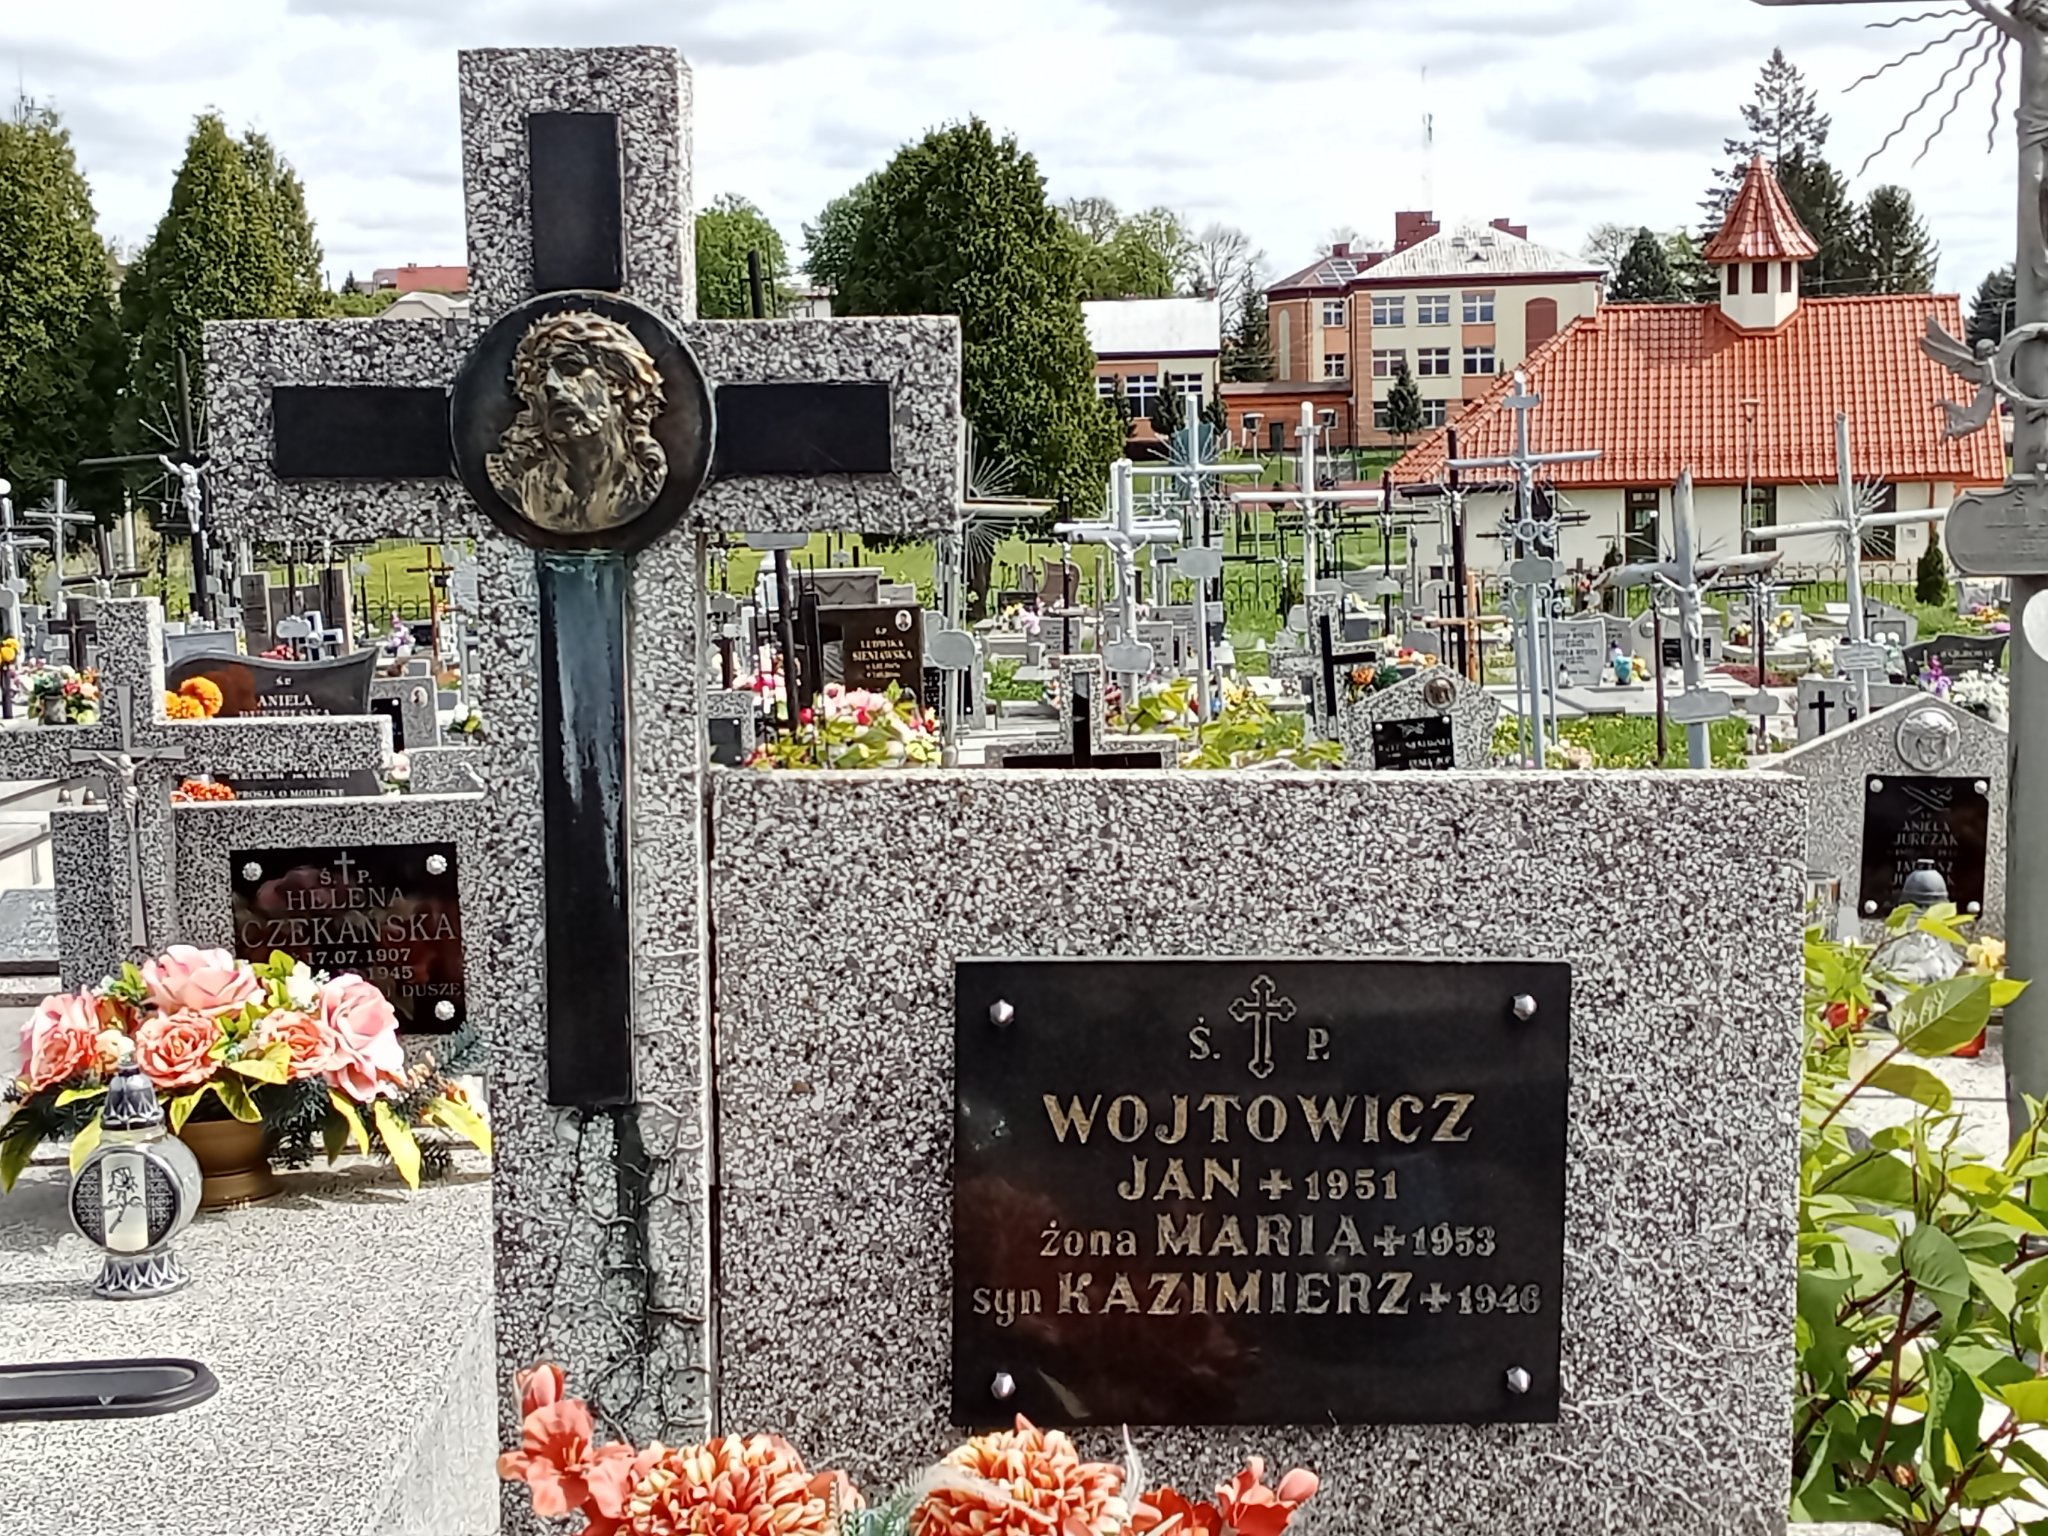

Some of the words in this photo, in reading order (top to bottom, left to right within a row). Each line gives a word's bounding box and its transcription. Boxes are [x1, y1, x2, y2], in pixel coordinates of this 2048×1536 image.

[257, 694, 313, 707] ANIELA
[278, 790, 288, 798] O
[1893, 833, 1959, 846] JURCZAK
[286, 887, 406, 911] HELENA
[307, 949, 411, 966] 17.07.1907
[1188, 1016, 1221, 1061] Ś.
[1306, 1026, 1331, 1061] P.
[1042, 1092, 1476, 1145] WOJTOWICZ
[1117, 1155, 1242, 1202] JAN
[1039, 1219, 1138, 1257] żona
[1156, 1213, 1367, 1258] MARIA
[972, 1286, 1043, 1327] syn
[1056, 1269, 1416, 1317] KAZIMIERZ
